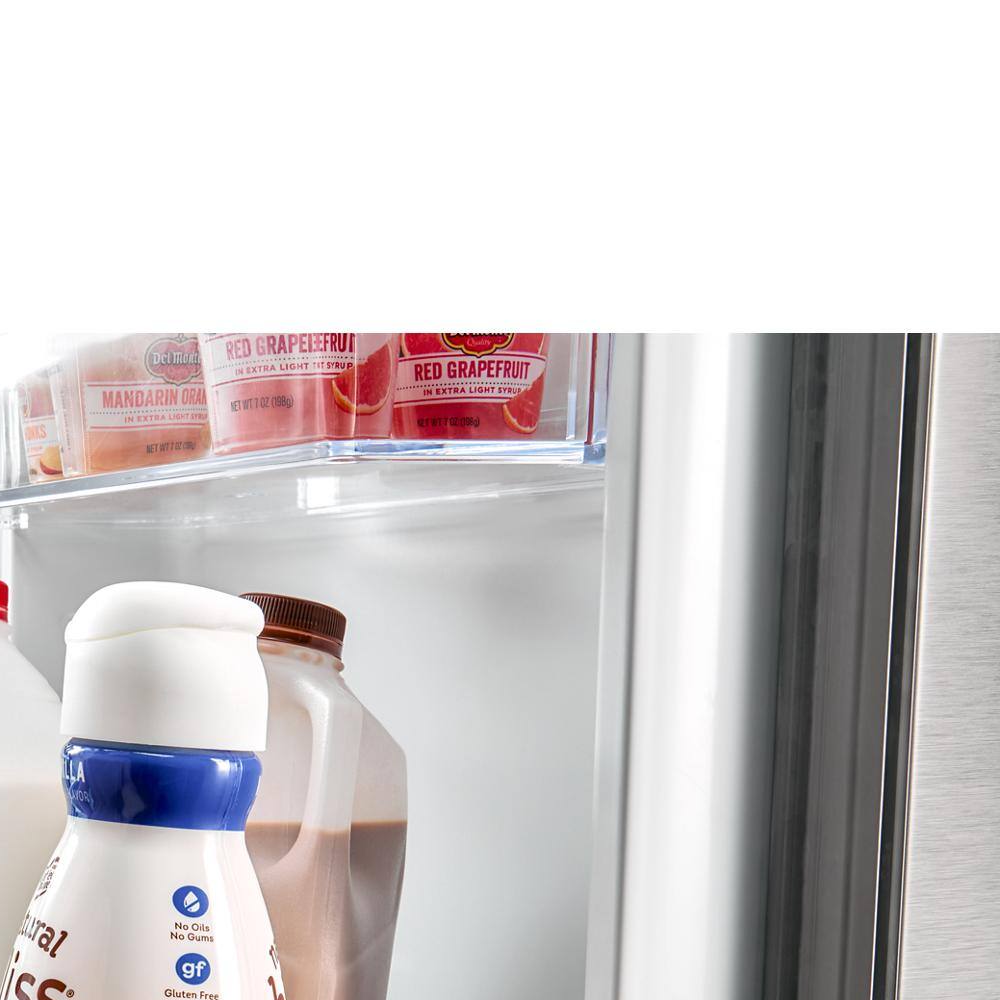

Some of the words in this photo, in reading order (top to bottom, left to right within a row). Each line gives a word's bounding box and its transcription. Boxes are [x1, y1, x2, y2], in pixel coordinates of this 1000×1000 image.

[226, 338, 251, 360] RED
[235, 367, 245, 376] IN
[246, 364, 276, 374] EXTRA
[280, 362, 309, 371] LIGHT
[327, 361, 354, 370] SYRUP
[414, 362, 442, 381] RED
[447, 360, 531, 380] GRAPEFRUIT
[423, 388, 433, 396] IN
[436, 386, 466, 396] EXTRA
[469, 386, 498, 394] LIGHT
[102, 388, 178, 408] MANDARIN
[125, 415, 134, 423] IN
[137, 414, 166, 422] EXTRA
[174, 922, 189, 931] No
[191, 923, 210, 932] Oils
[170, 932, 185, 941] No
[187, 932, 215, 943] Gums
[182, 960, 206, 979] gf
[164, 988, 197, 999] Gluten
[200, 990, 219, 1000] Free
